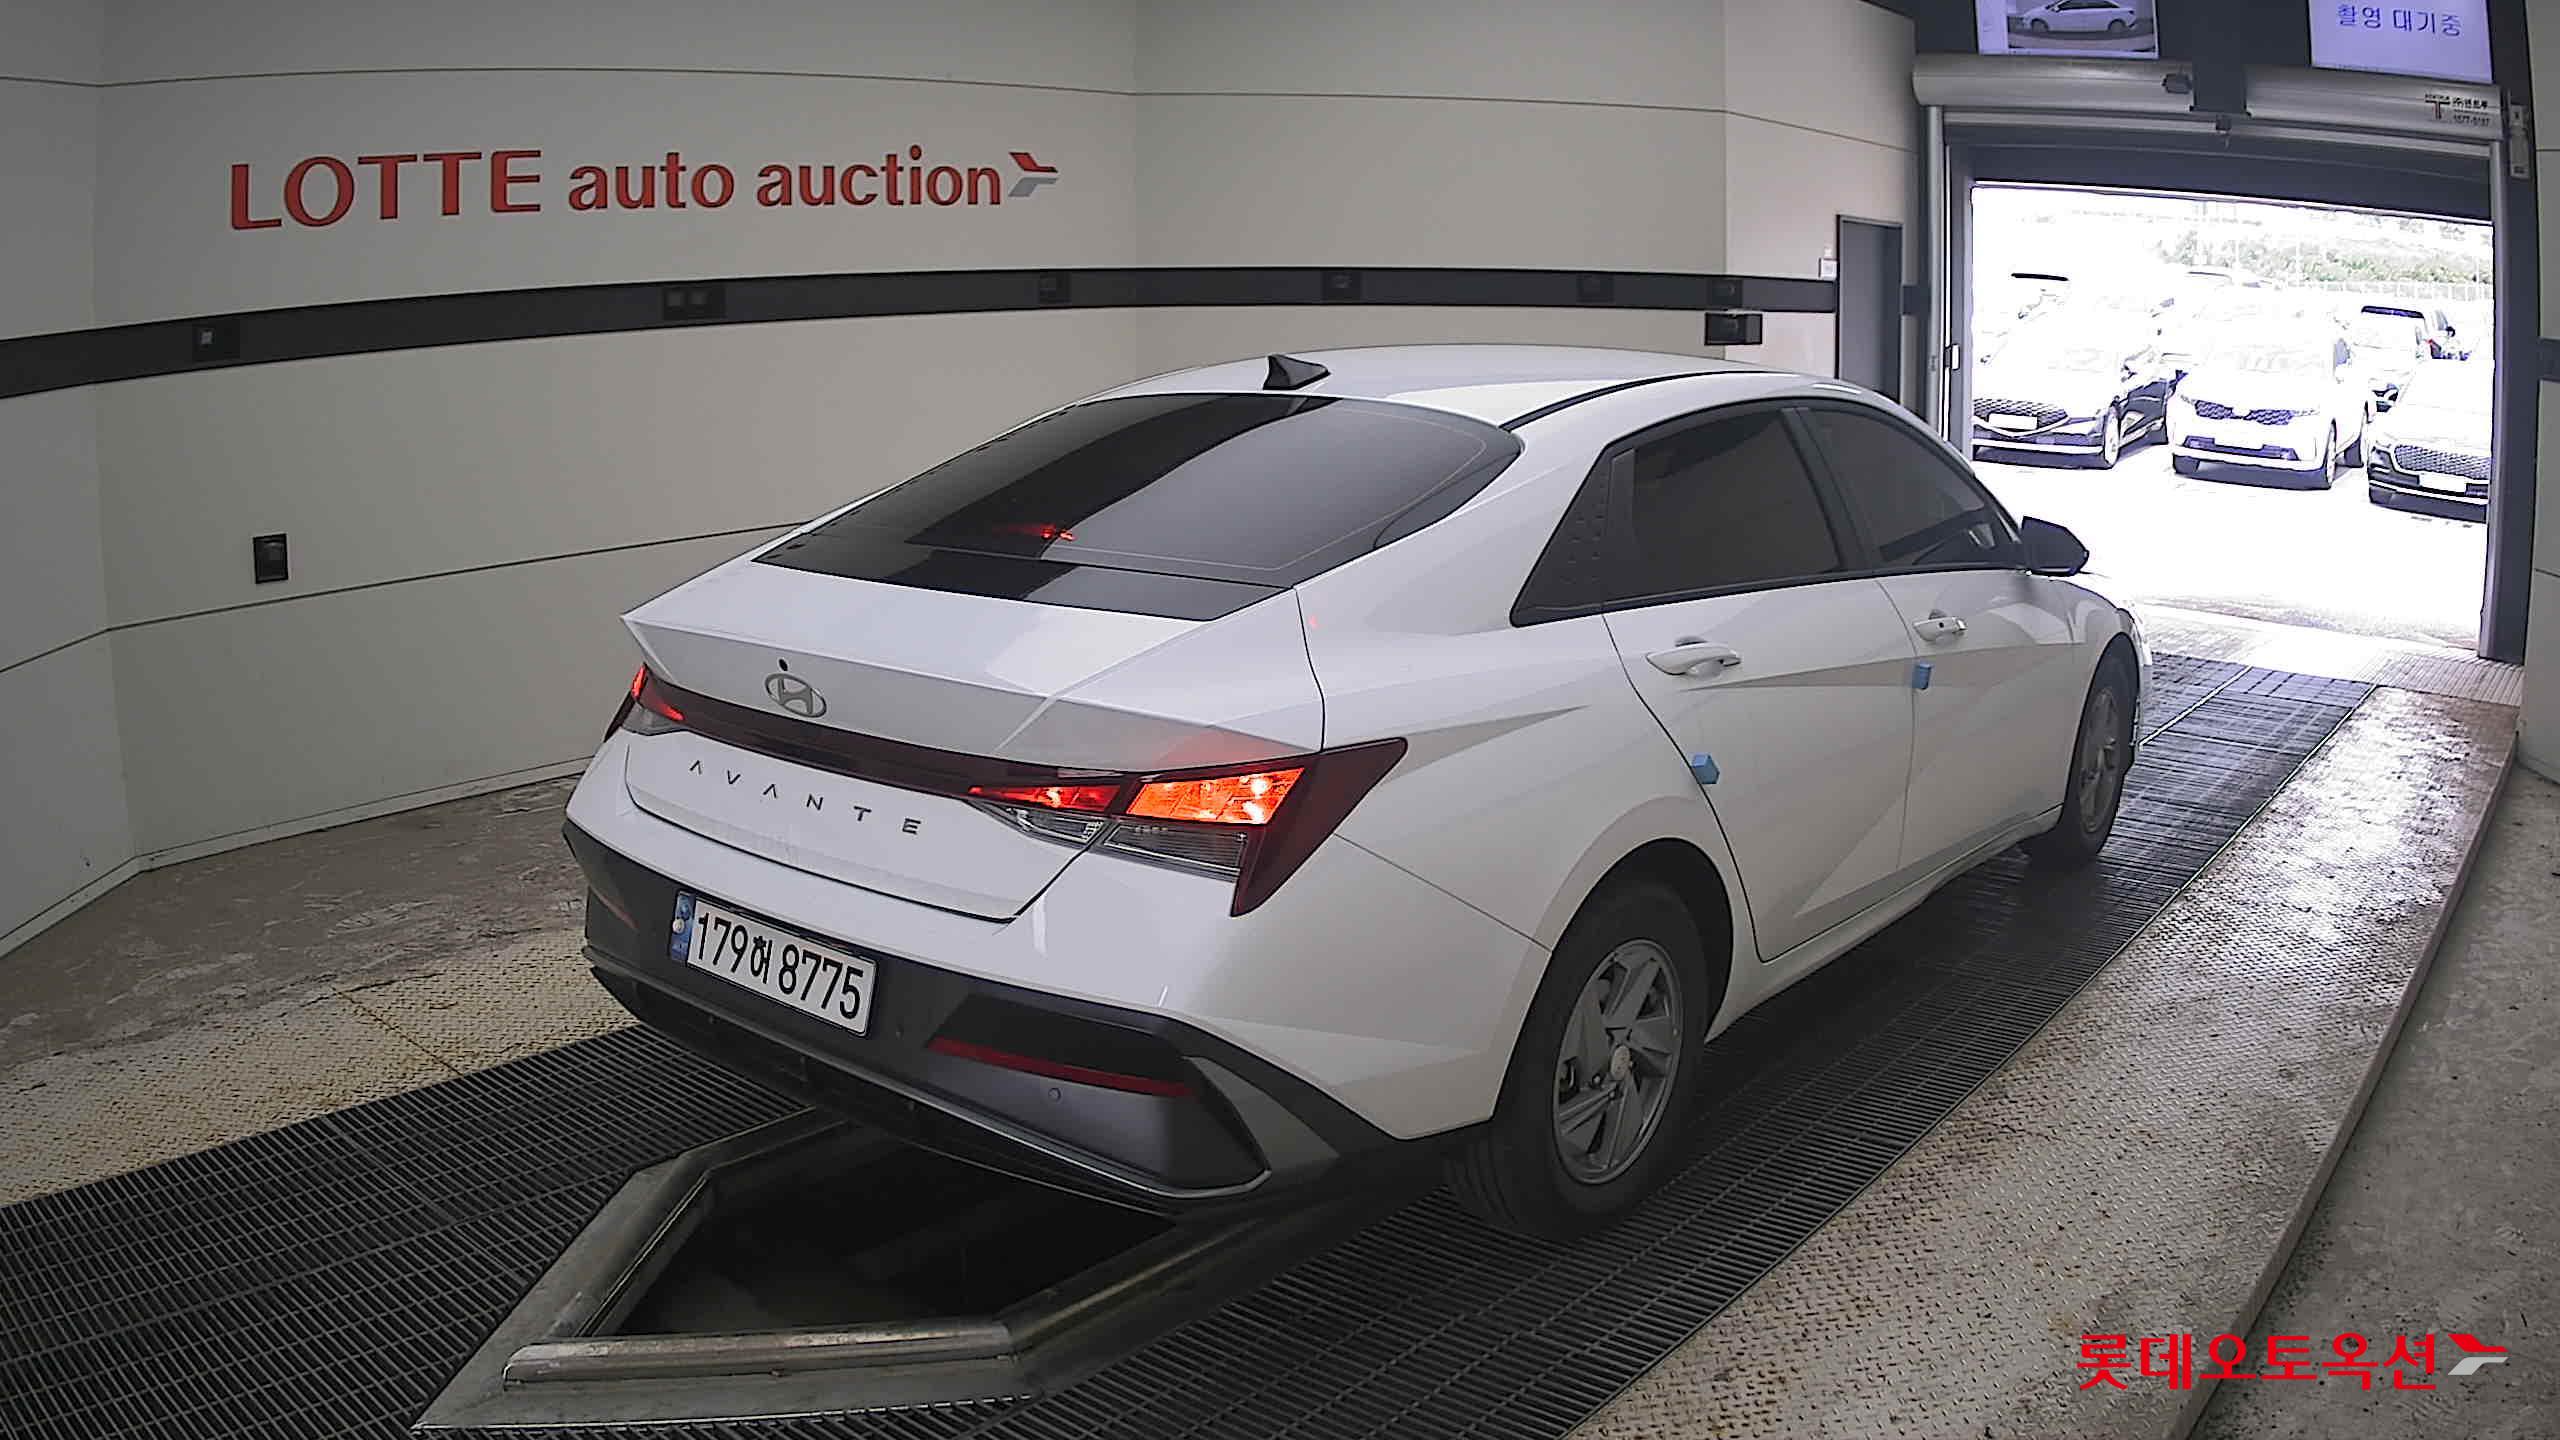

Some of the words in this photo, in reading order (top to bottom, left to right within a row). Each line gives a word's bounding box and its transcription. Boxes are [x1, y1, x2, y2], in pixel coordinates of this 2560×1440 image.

[2338, 4, 2382, 29] 촬영
[2392, 9, 2461, 36] 대기중
[231, 149, 542, 231] LOTTE
[568, 151, 735, 210] auto
[756, 145, 1001, 207] auction
[689, 759, 922, 836] AVANTE
[698, 911, 774, 985] 179허
[778, 943, 865, 1020] 8775
